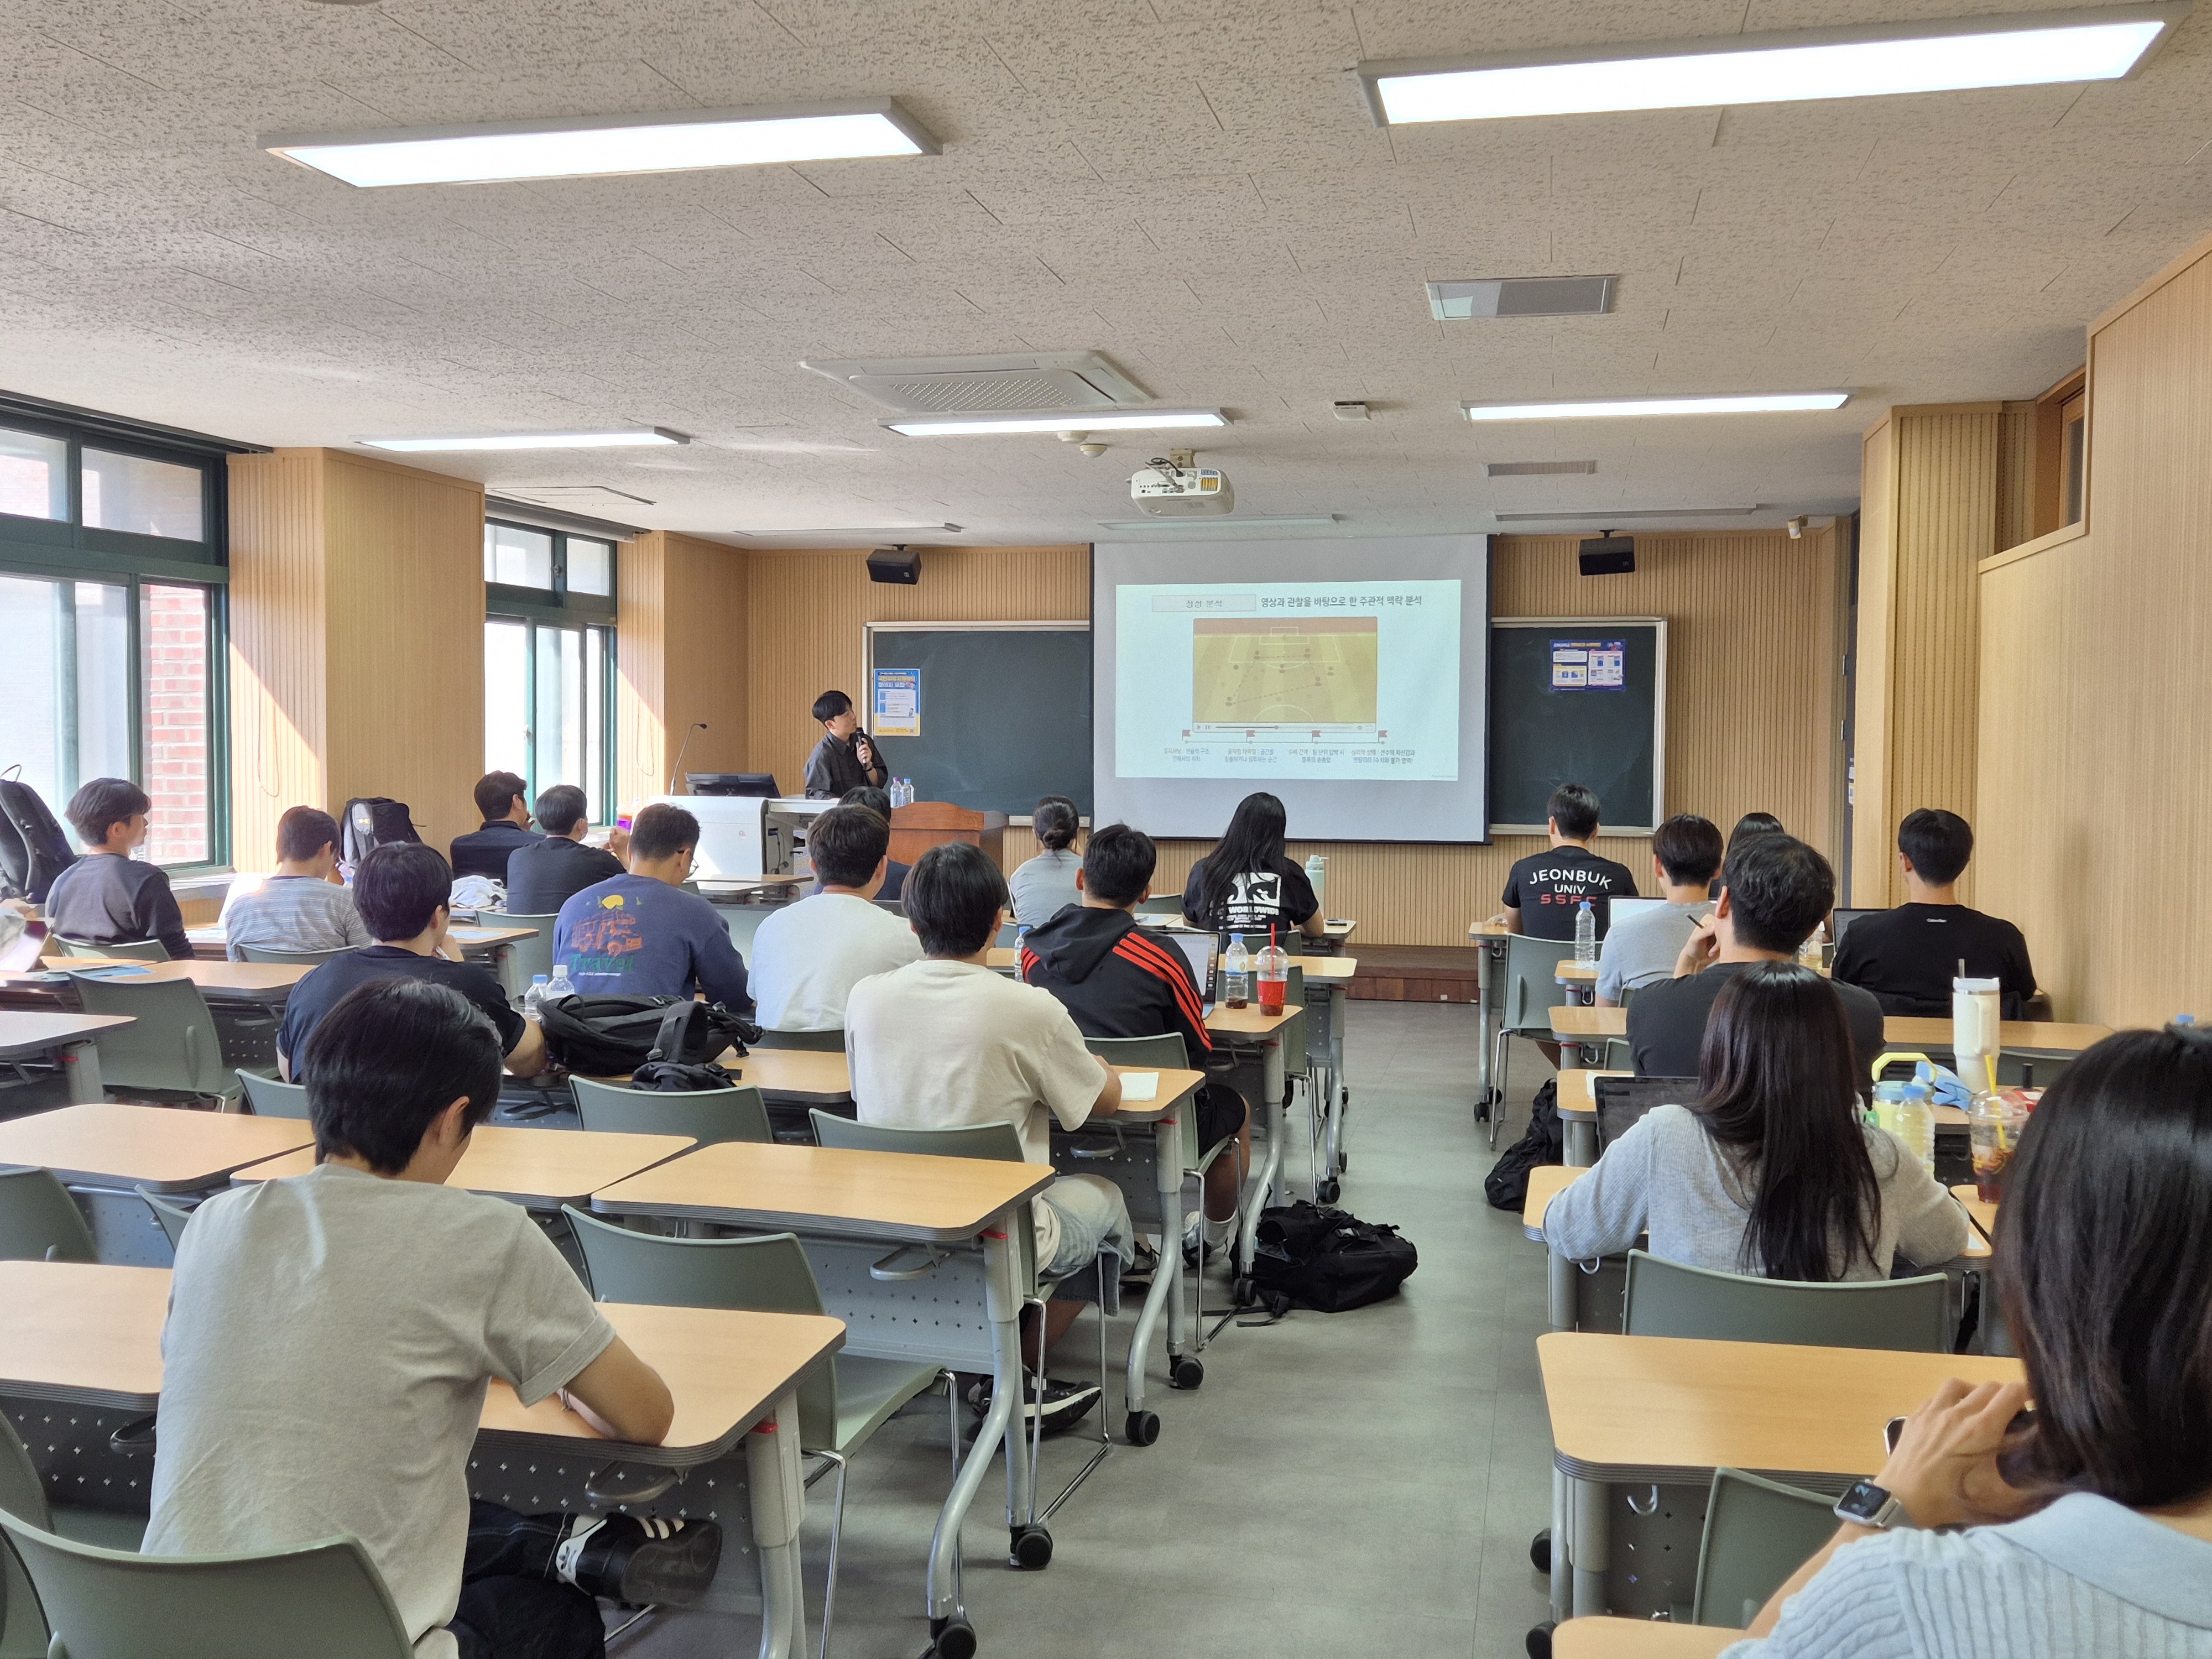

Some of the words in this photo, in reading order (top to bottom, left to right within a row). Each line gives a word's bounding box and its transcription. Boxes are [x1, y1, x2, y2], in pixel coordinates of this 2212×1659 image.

[1206, 599, 1222, 608] 분석
[1261, 597, 1285, 608] 영상과
[1287, 597, 1311, 607] 관찰을
[1314, 597, 1347, 607] 바탕으로
[1349, 596, 1357, 607] 한
[1359, 596, 1384, 606] 주관적
[1386, 596, 1403, 606] 맥락
[1405, 595, 1422, 606] 분석
[1529, 869, 1613, 890] JEONBUK
[1554, 884, 1586, 894] UNIV
[570, 953, 635, 972] Travel
